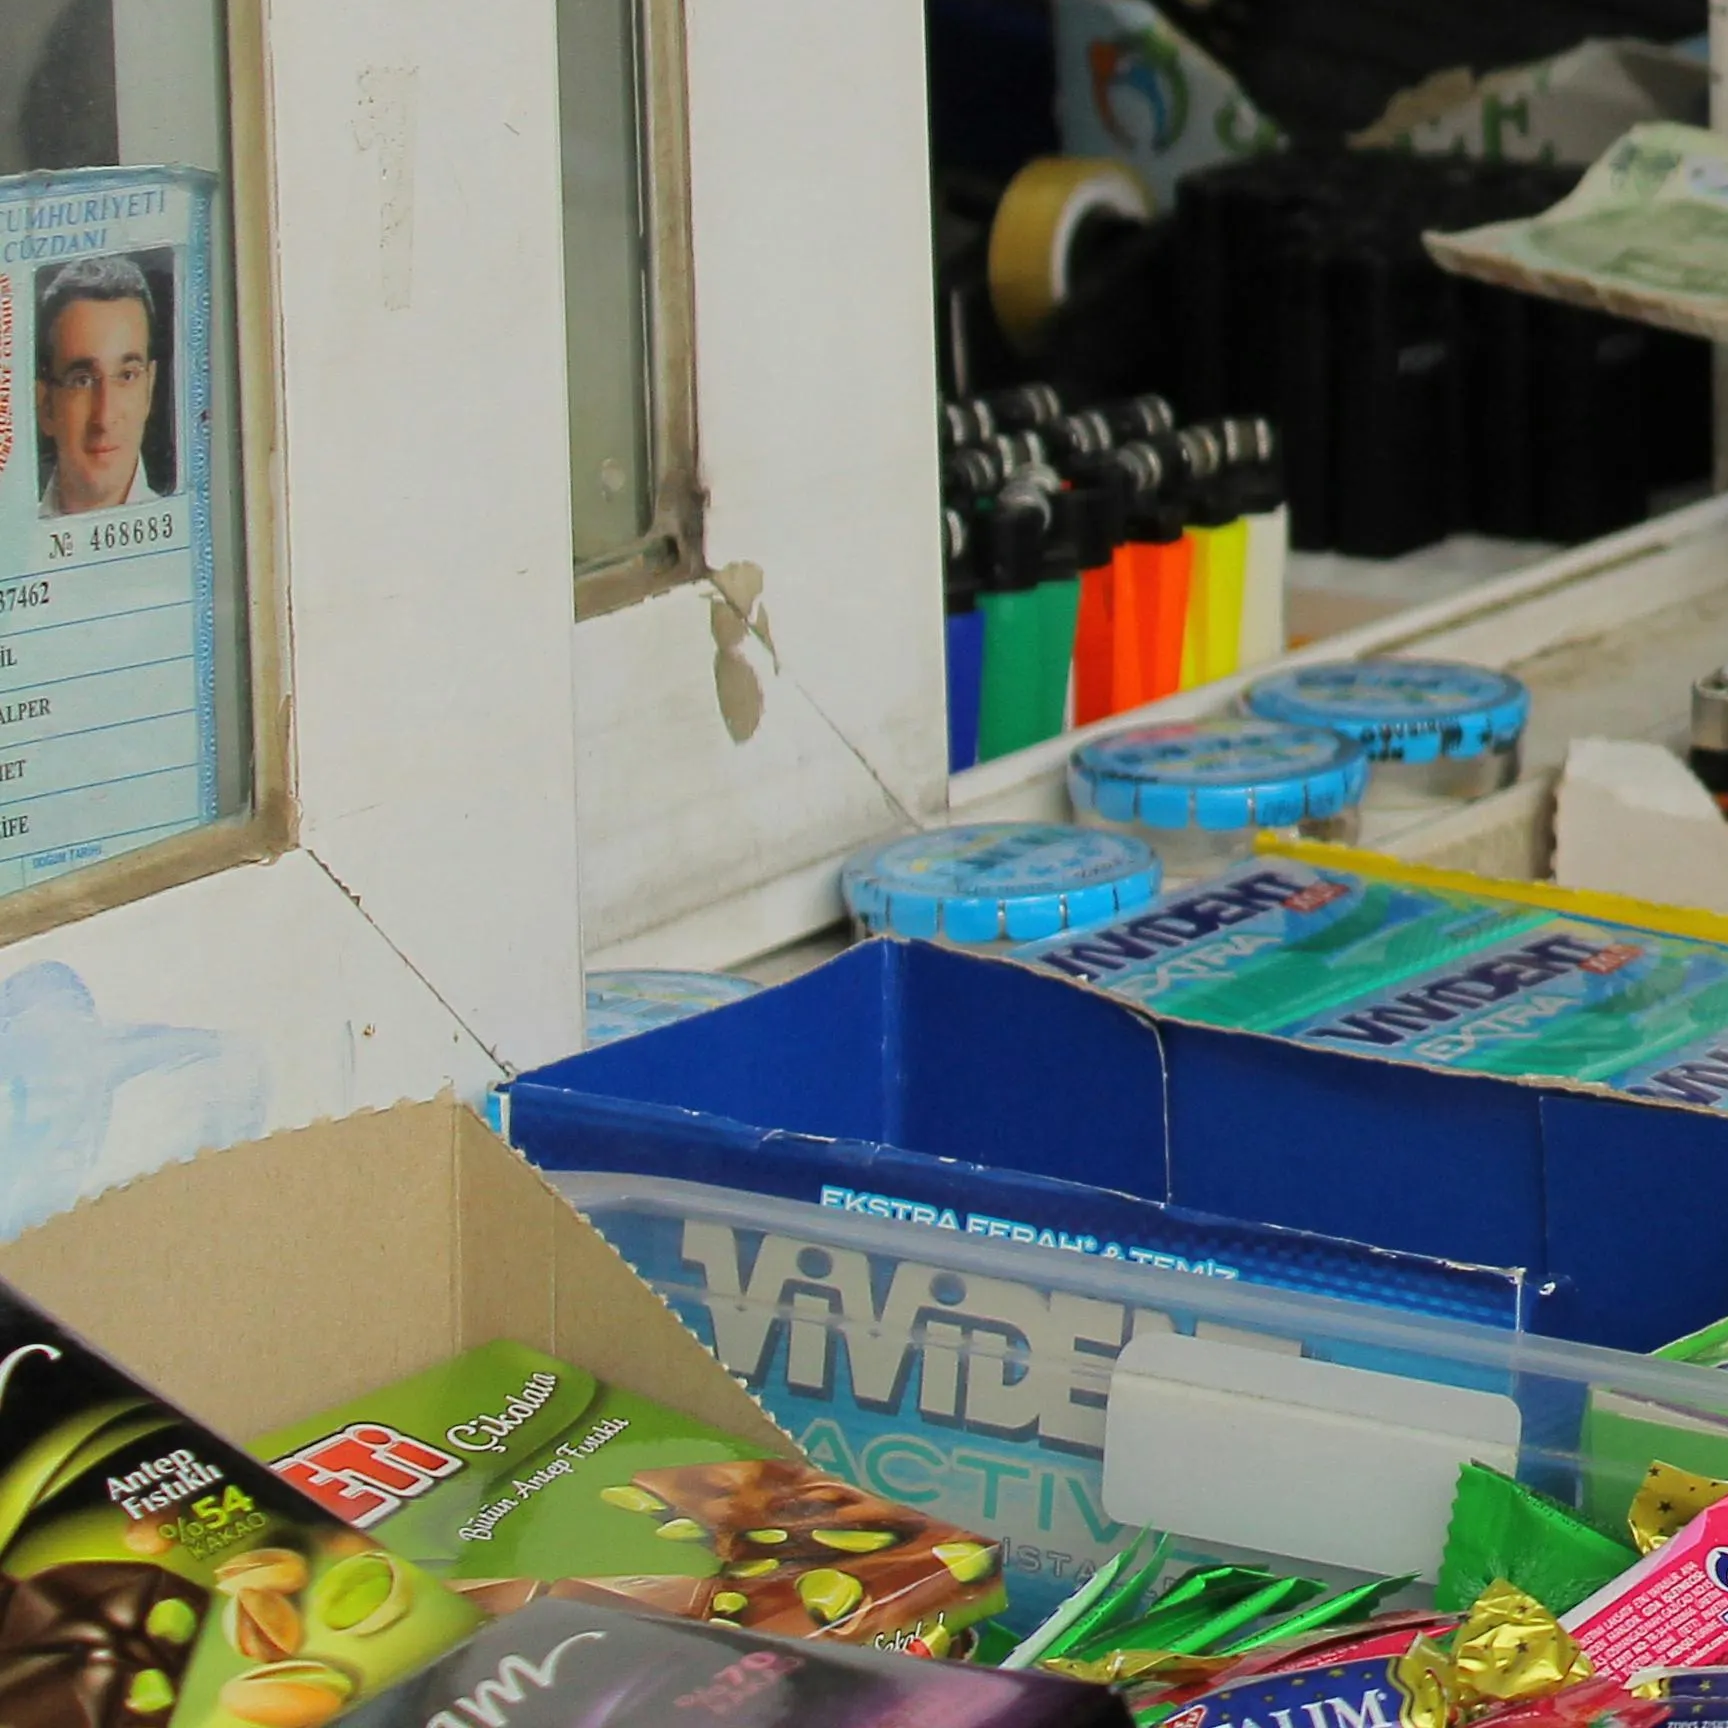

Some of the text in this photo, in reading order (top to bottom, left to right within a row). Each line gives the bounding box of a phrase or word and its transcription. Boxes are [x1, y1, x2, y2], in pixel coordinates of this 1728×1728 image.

[0, 190, 165, 232] UMHURİYETİ
[90, 513, 173, 551] 468683
[446, 1372, 557, 1454] Çikolata
[106, 1449, 196, 1502] Antep
[459, 1497, 520, 1543] Bütün
[512, 1458, 574, 1500] Antep
[189, 1512, 268, 1561] KAKAO
